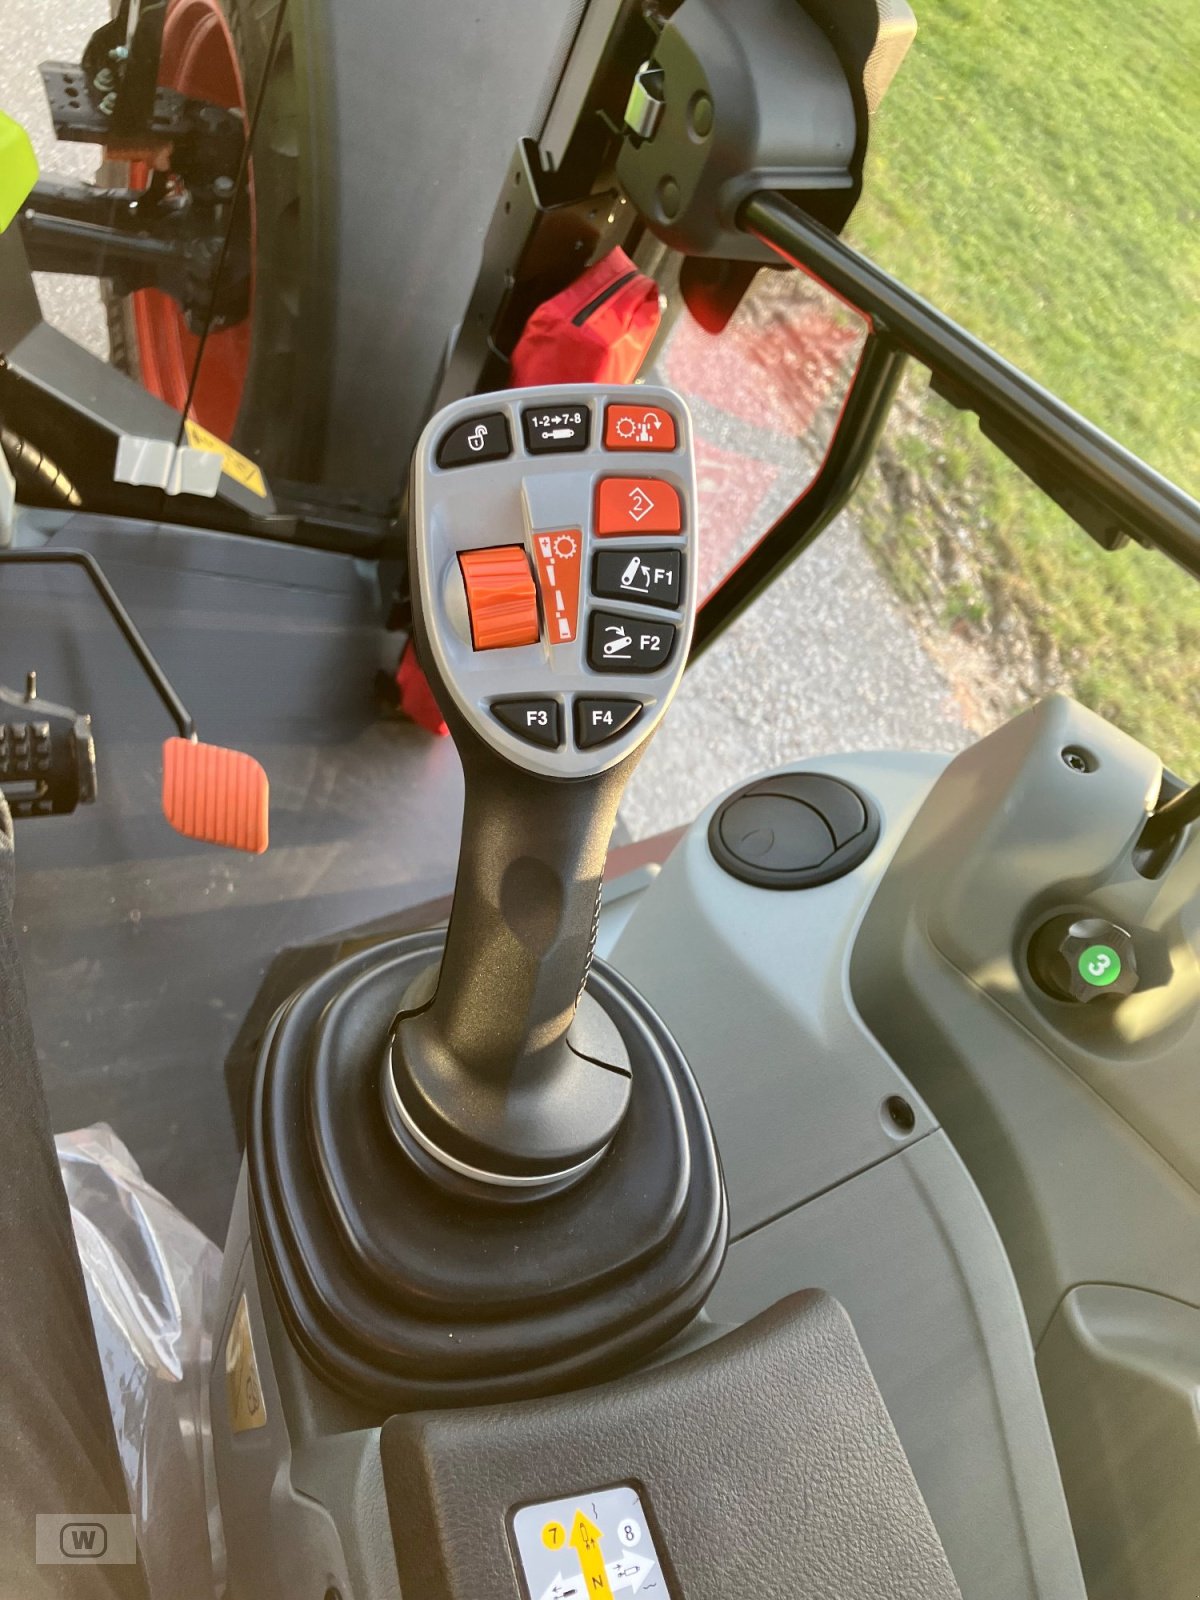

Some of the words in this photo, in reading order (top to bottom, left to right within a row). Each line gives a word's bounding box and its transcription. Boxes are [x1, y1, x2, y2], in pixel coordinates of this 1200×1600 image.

[632, 495, 643, 511] 2
[653, 568, 673, 585] F1
[640, 635, 660, 651] F2
[526, 710, 548, 727] F3
[592, 710, 614, 726] F4
[1088, 953, 1111, 977] 3
[548, 1527, 557, 1544] 7
[624, 1525, 634, 1541] 8
[592, 1575, 603, 1589] N
